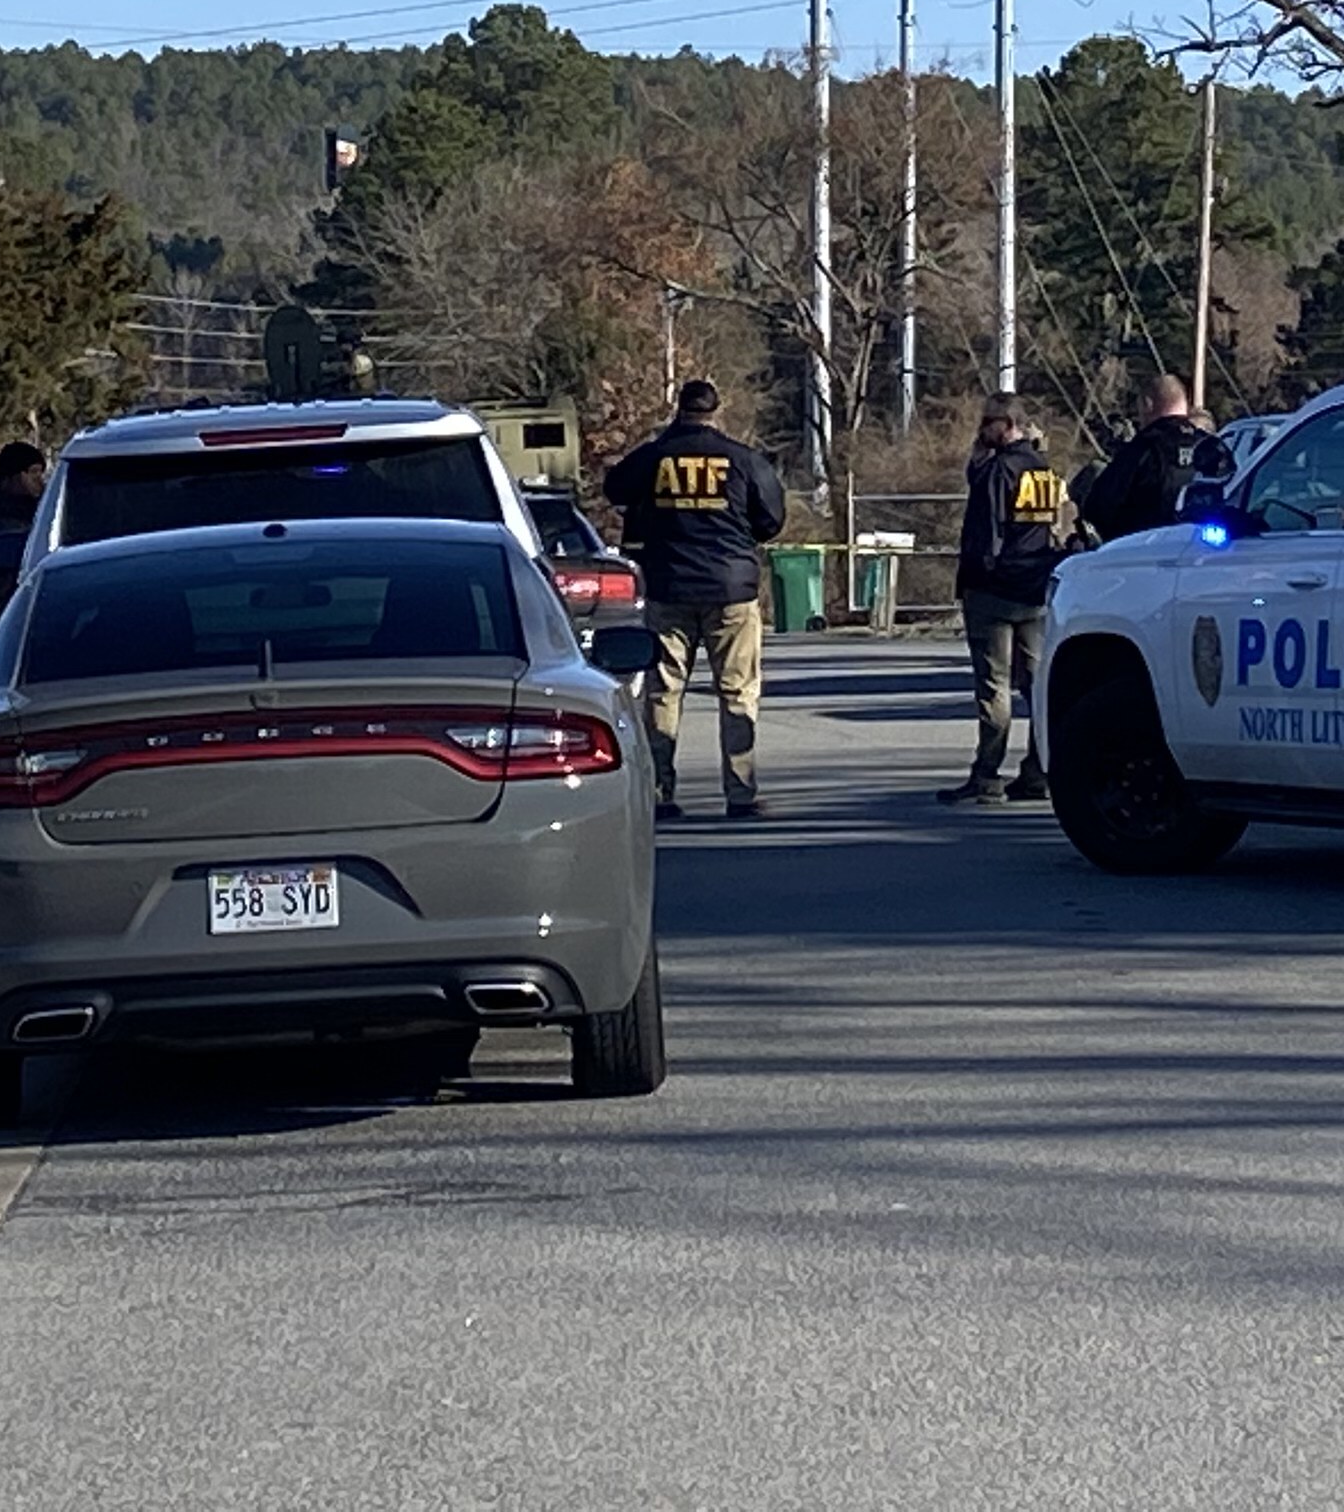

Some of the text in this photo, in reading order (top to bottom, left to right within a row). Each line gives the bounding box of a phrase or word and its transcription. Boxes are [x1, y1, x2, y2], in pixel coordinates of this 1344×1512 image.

[655, 456, 730, 495] ATF
[1238, 706, 1304, 745] NORTH
[215, 883, 331, 919] 558 SYD
